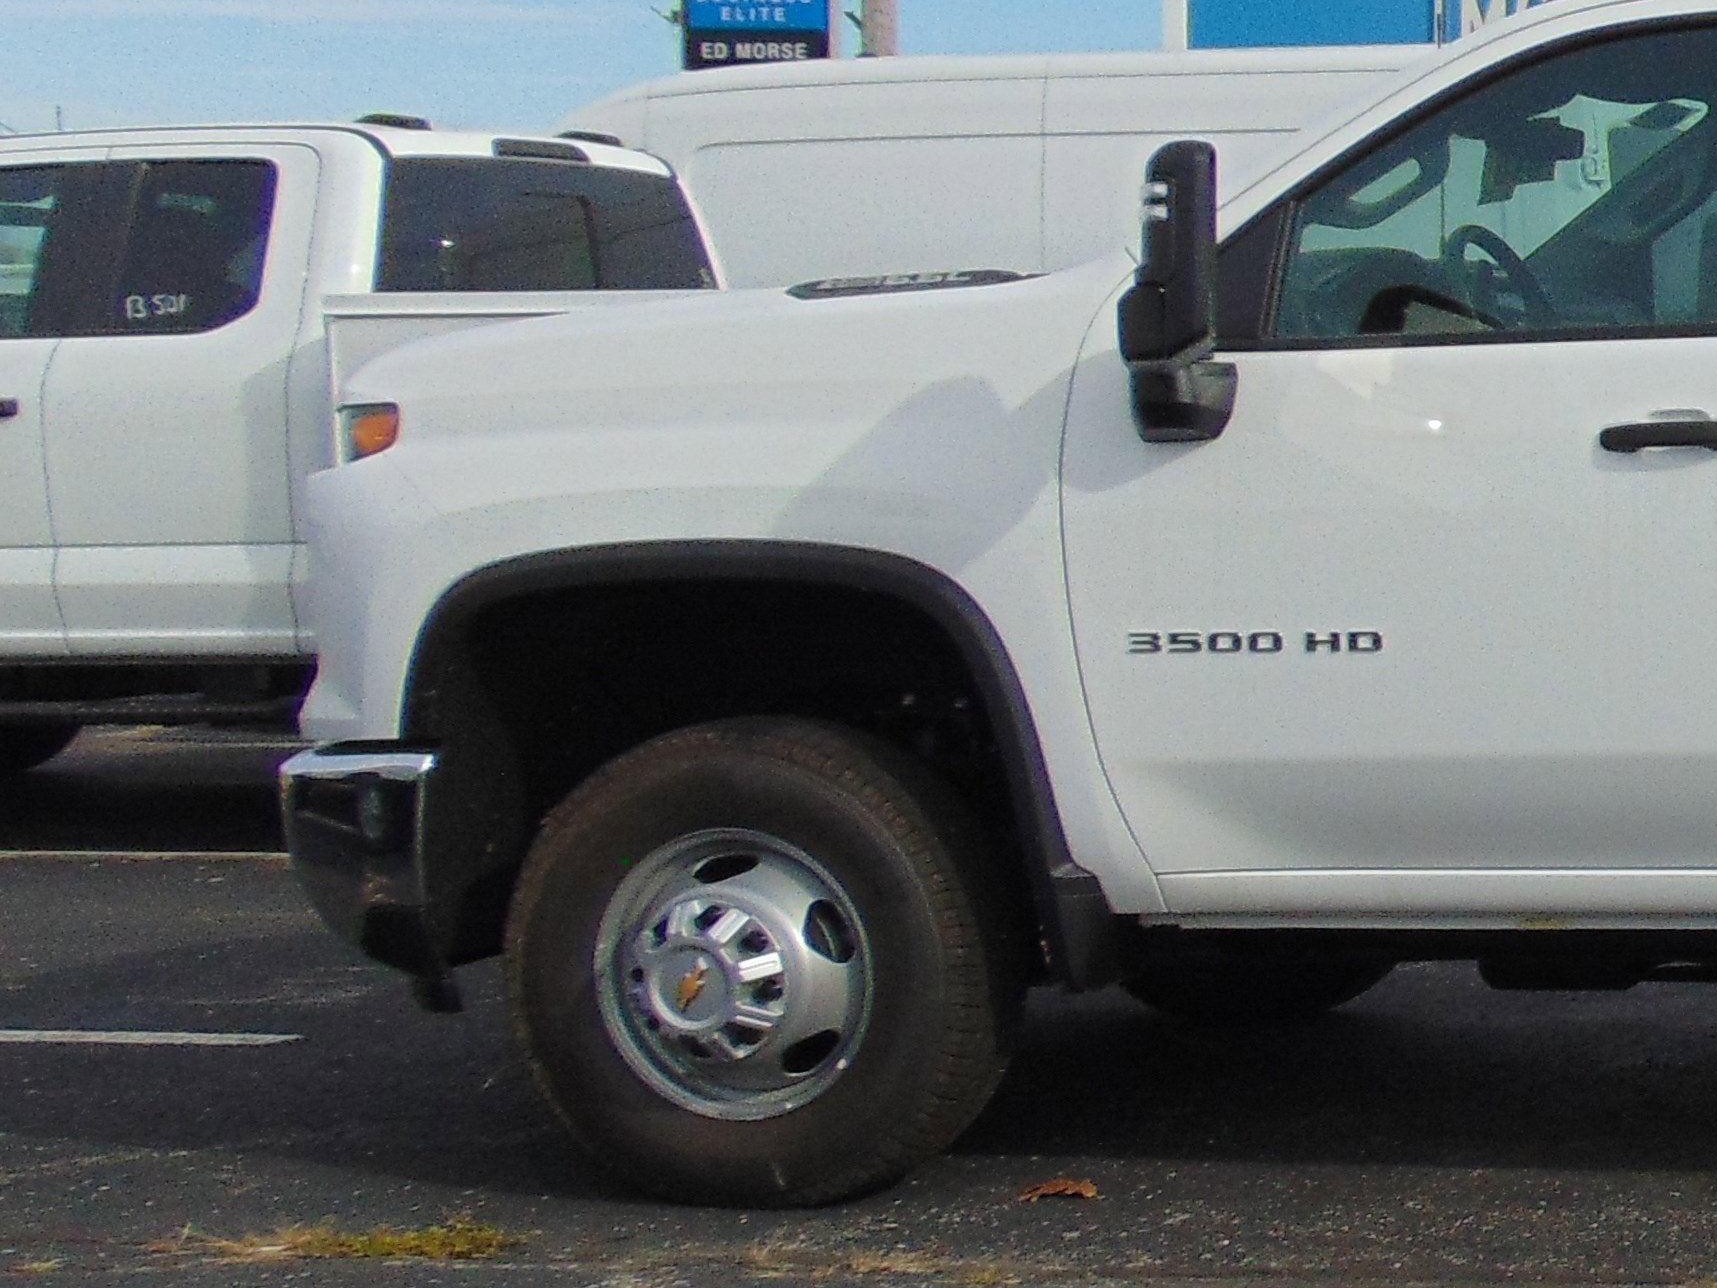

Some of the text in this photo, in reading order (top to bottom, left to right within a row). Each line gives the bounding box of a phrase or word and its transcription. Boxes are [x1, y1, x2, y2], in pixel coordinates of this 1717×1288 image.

[720, 6, 786, 23] ELITE
[700, 41, 809, 60] ED MORSE
[1127, 631, 1384, 654] 3500 HD
